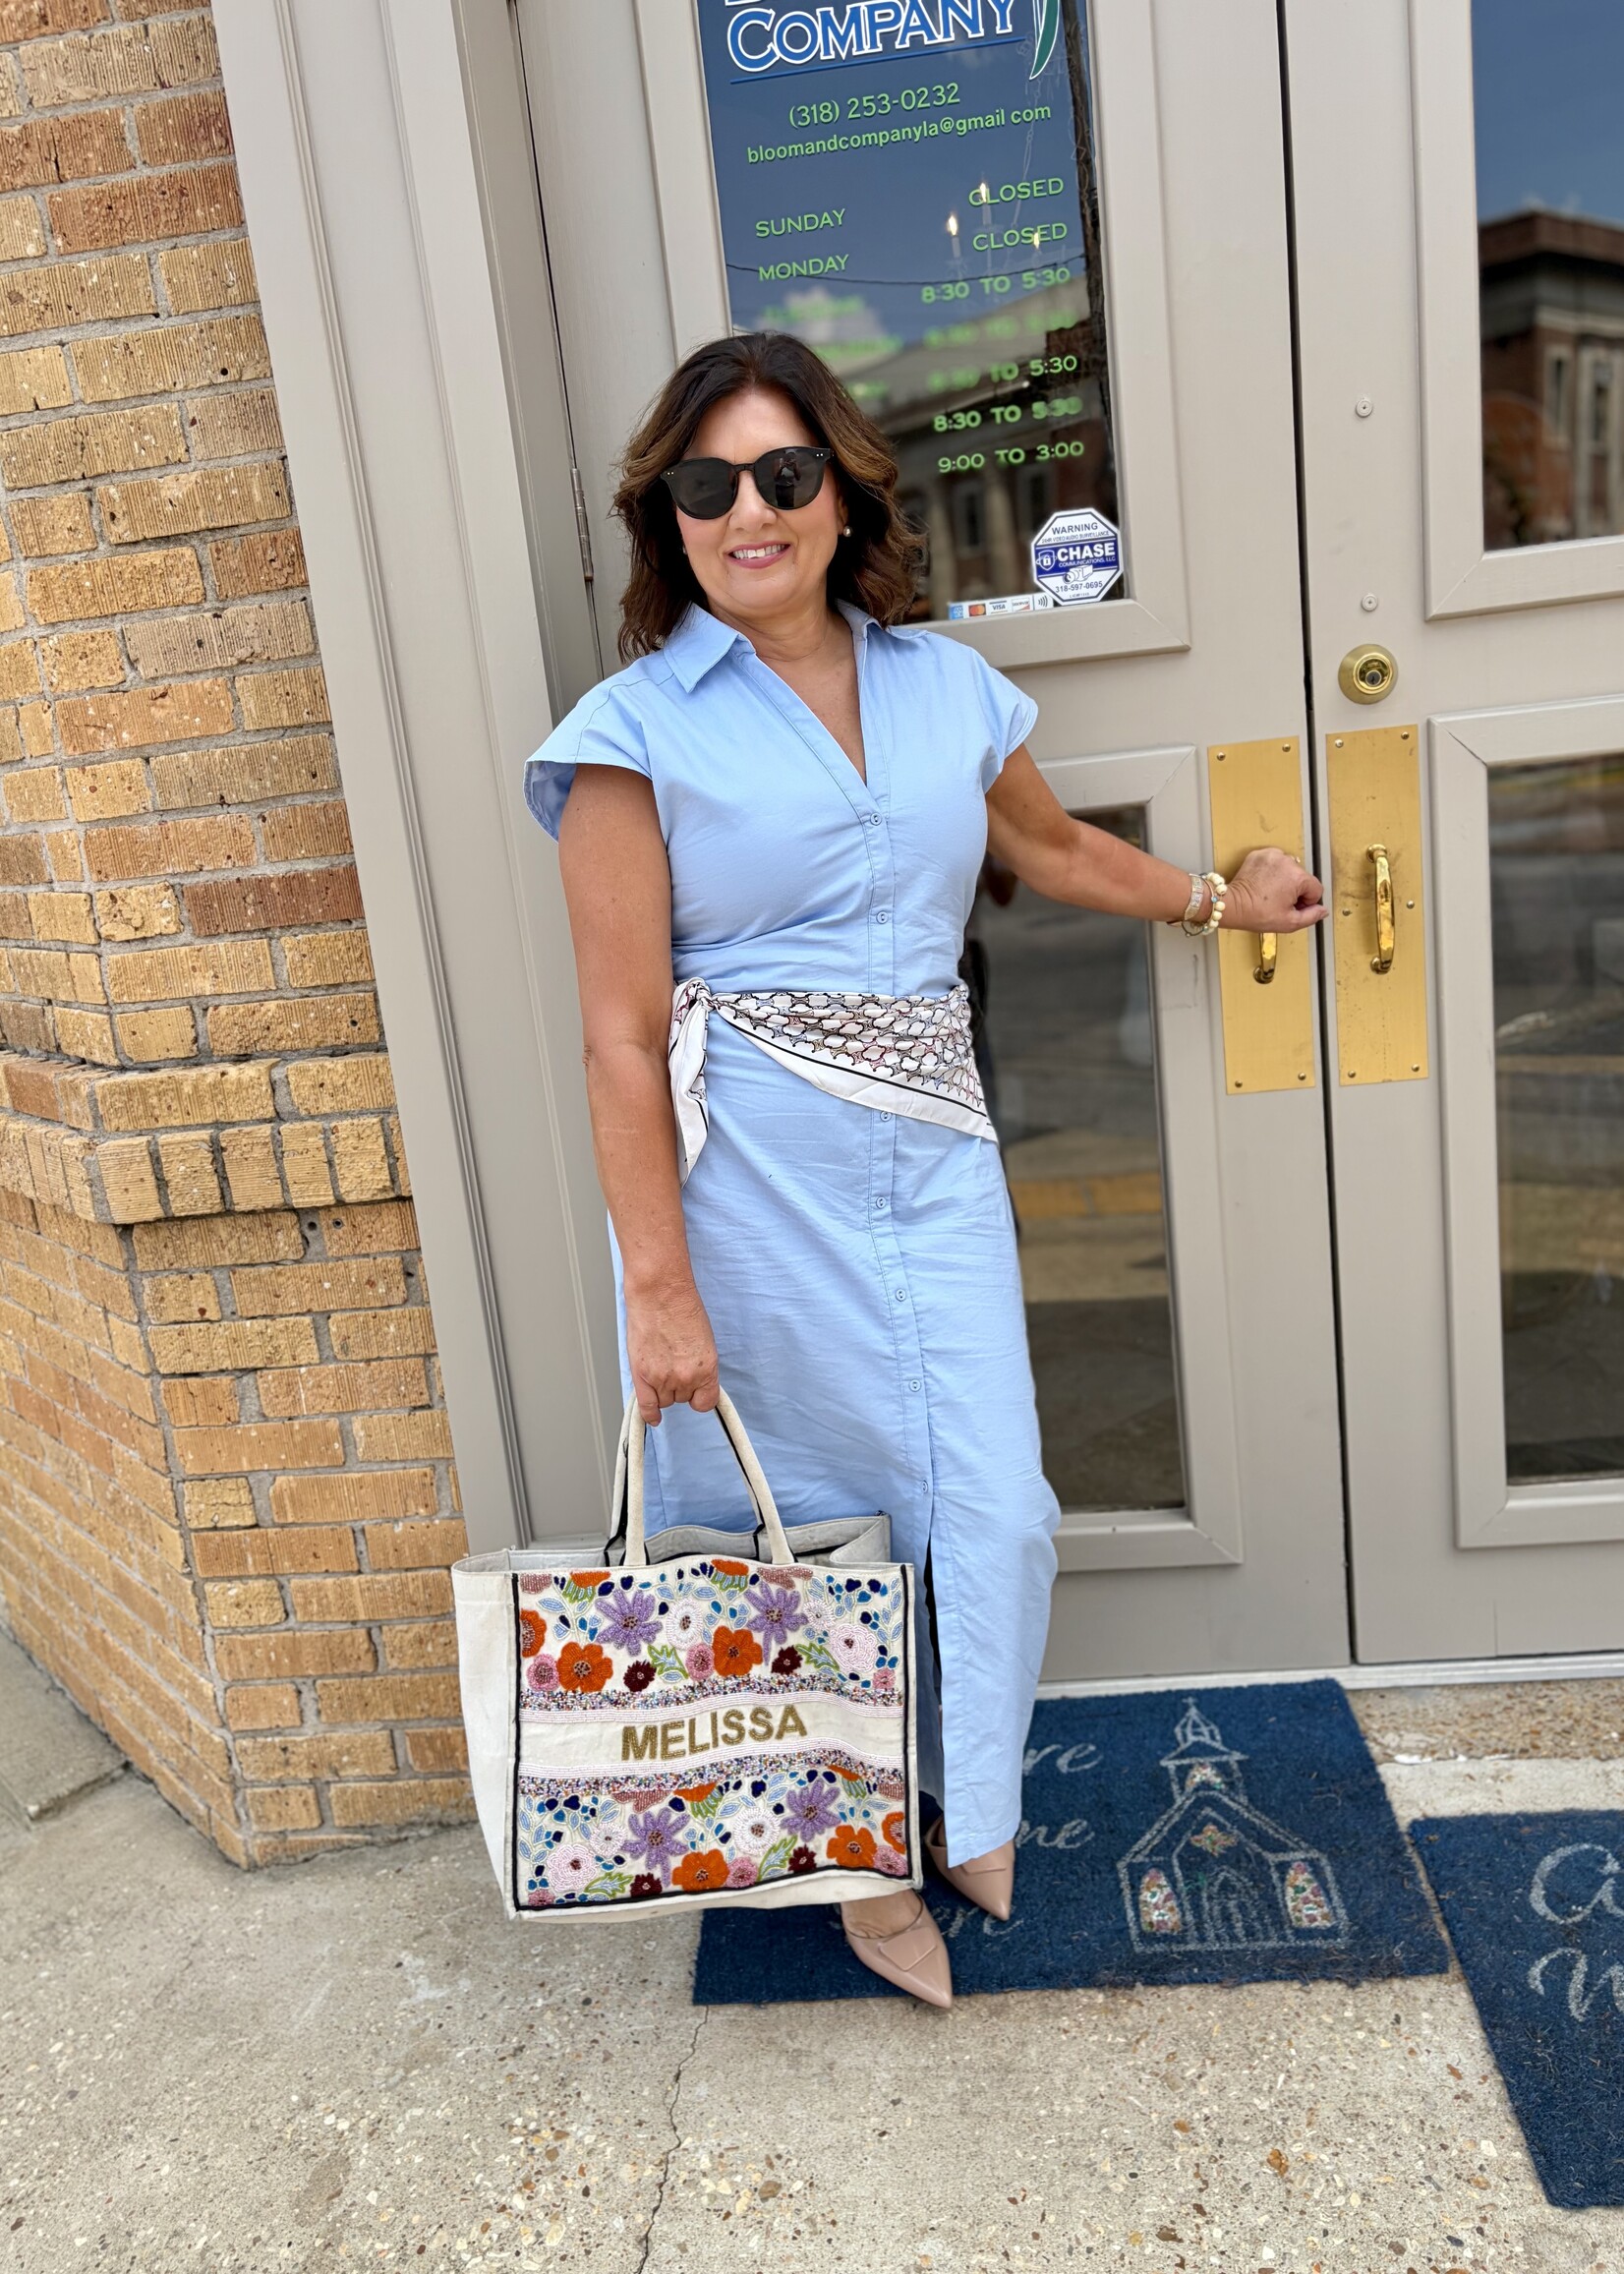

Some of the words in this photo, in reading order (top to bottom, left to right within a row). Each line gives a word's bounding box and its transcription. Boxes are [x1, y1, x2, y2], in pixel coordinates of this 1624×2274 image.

[726, 0, 1015, 72] COMPANY
[788, 100, 841, 129] (318)
[846, 83, 961, 119] 253-0232
[755, 208, 845, 237] SUNDAY
[968, 178, 1065, 206] CLOSED
[759, 254, 849, 281] MONDAY
[972, 223, 1068, 251] CLOSED
[921, 281, 970, 304] 8:30
[979, 276, 1012, 295] TO
[1021, 267, 1071, 289] 5:30
[1029, 355, 1077, 376] 5:30
[934, 410, 982, 432] 8:30
[990, 405, 1022, 424] TO
[938, 453, 985, 473] 9:00
[994, 447, 1025, 466] TO
[1035, 441, 1084, 460] 3:00
[1052, 522, 1098, 535] WARNING
[1057, 542, 1116, 561] CHASE
[1056, 581, 1103, 593] 318-597-0695
[620, 1705, 808, 1761] MELISSA
